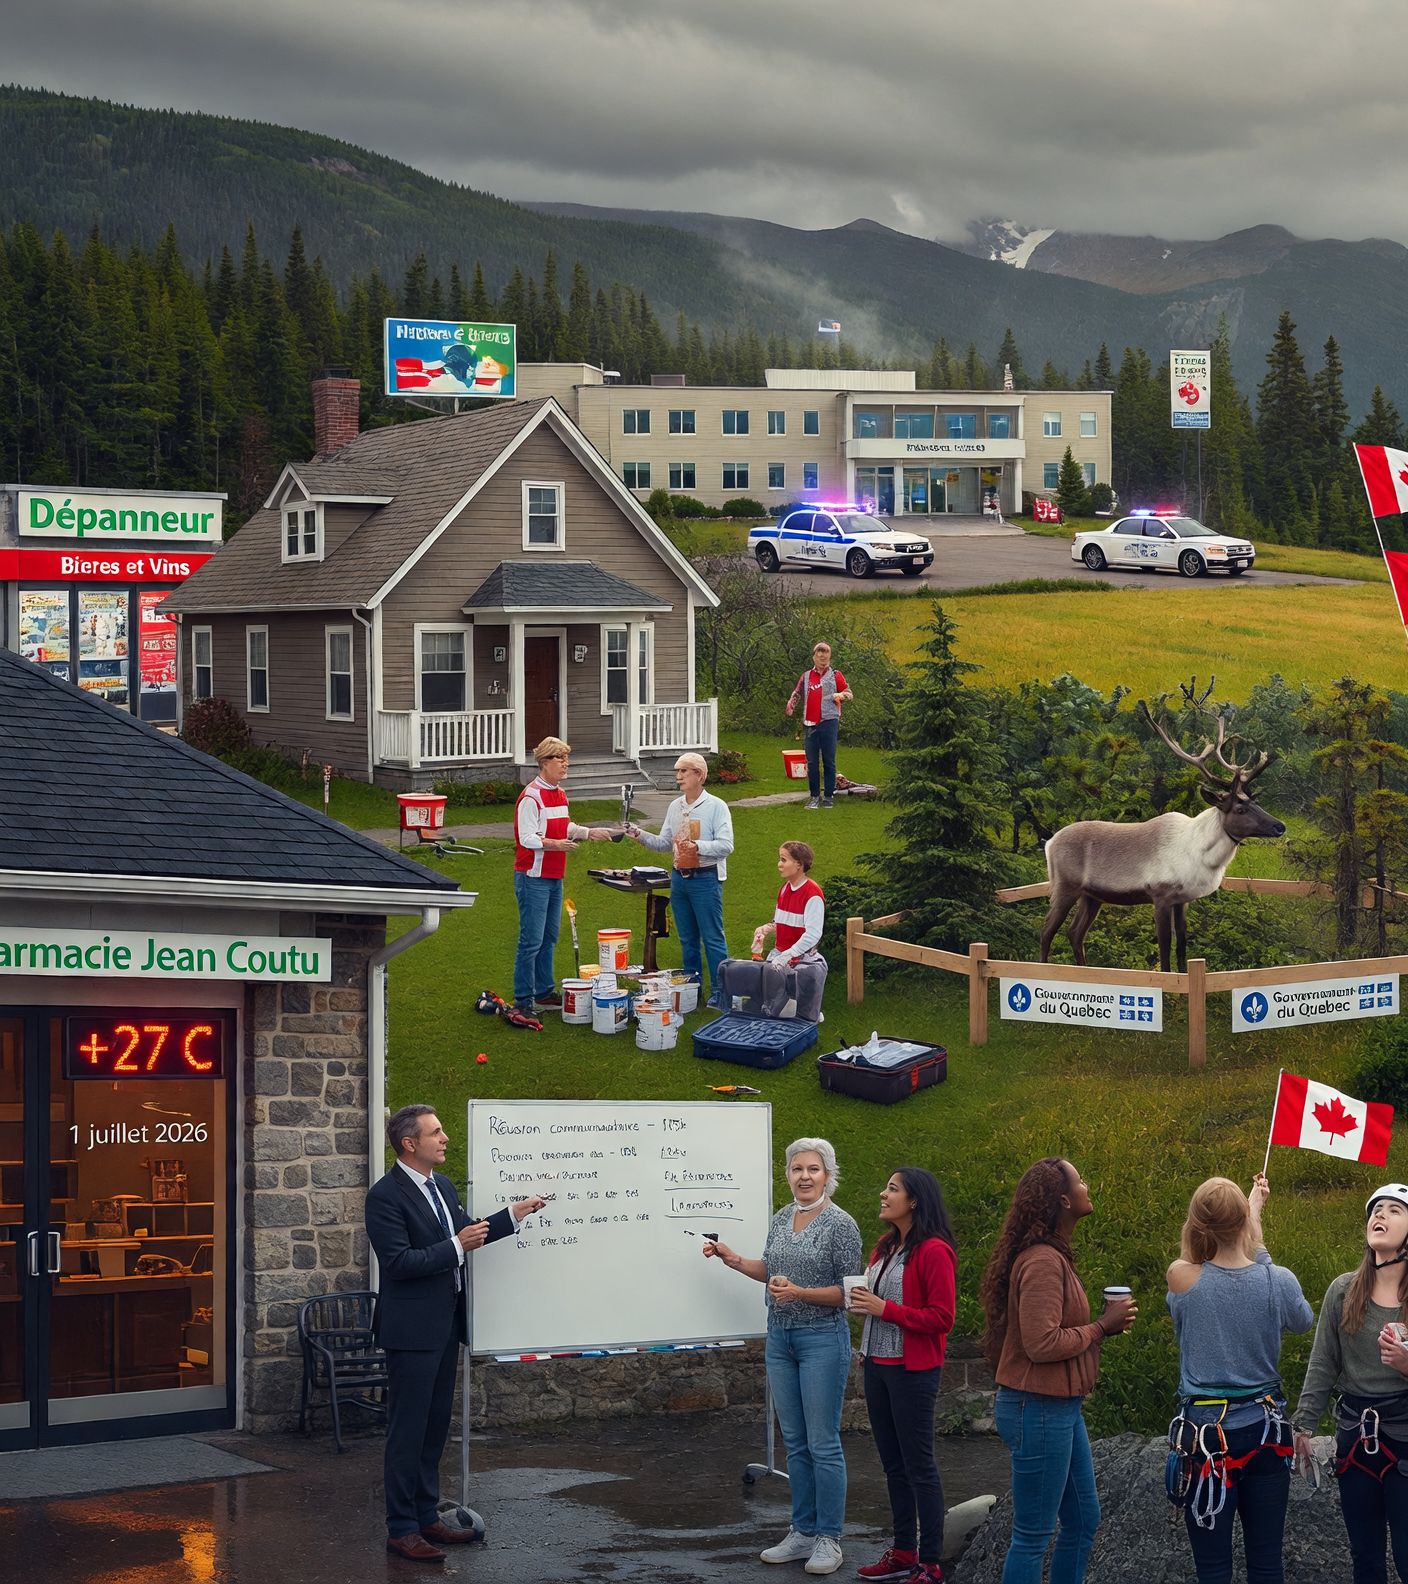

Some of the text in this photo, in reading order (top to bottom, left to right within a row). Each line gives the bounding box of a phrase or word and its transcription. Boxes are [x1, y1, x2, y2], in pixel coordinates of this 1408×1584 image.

[29, 498, 214, 537] Dépanneur
[127, 559, 145, 576] et
[149, 558, 190, 576] Vins
[141, 938, 217, 972] Jean
[226, 941, 320, 975] Coutu
[1039, 1001, 1112, 1019] du Quebec
[1277, 1000, 1351, 1019] du Quebec
[79, 1025, 213, 1071] +27 C
[69, 1122, 208, 1150] 1 juillet 2026
